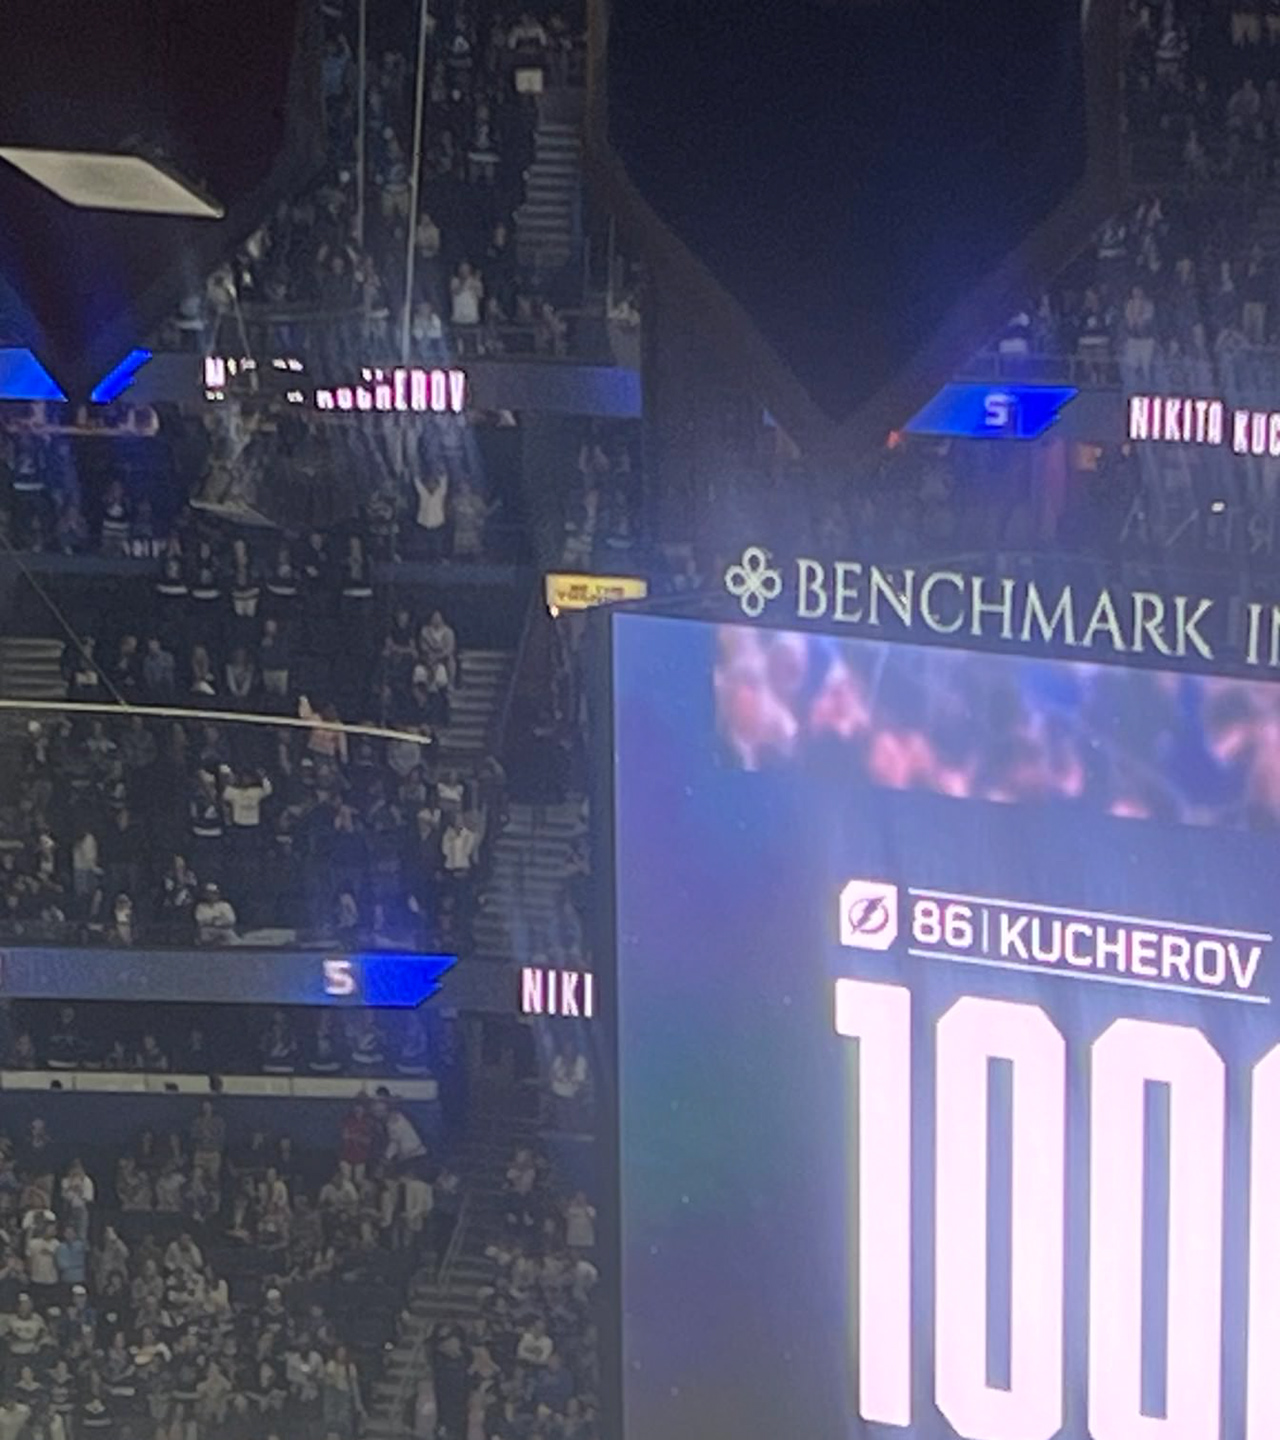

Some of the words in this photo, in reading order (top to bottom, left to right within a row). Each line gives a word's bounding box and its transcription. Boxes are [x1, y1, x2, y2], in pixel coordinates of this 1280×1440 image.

[1129, 397, 1222, 445] NIKITA
[796, 558, 1214, 661] BENCHMARK
[912, 901, 974, 949] 86
[1000, 915, 1261, 990] KUCHEROV
[522, 967, 594, 1019] NIKI
